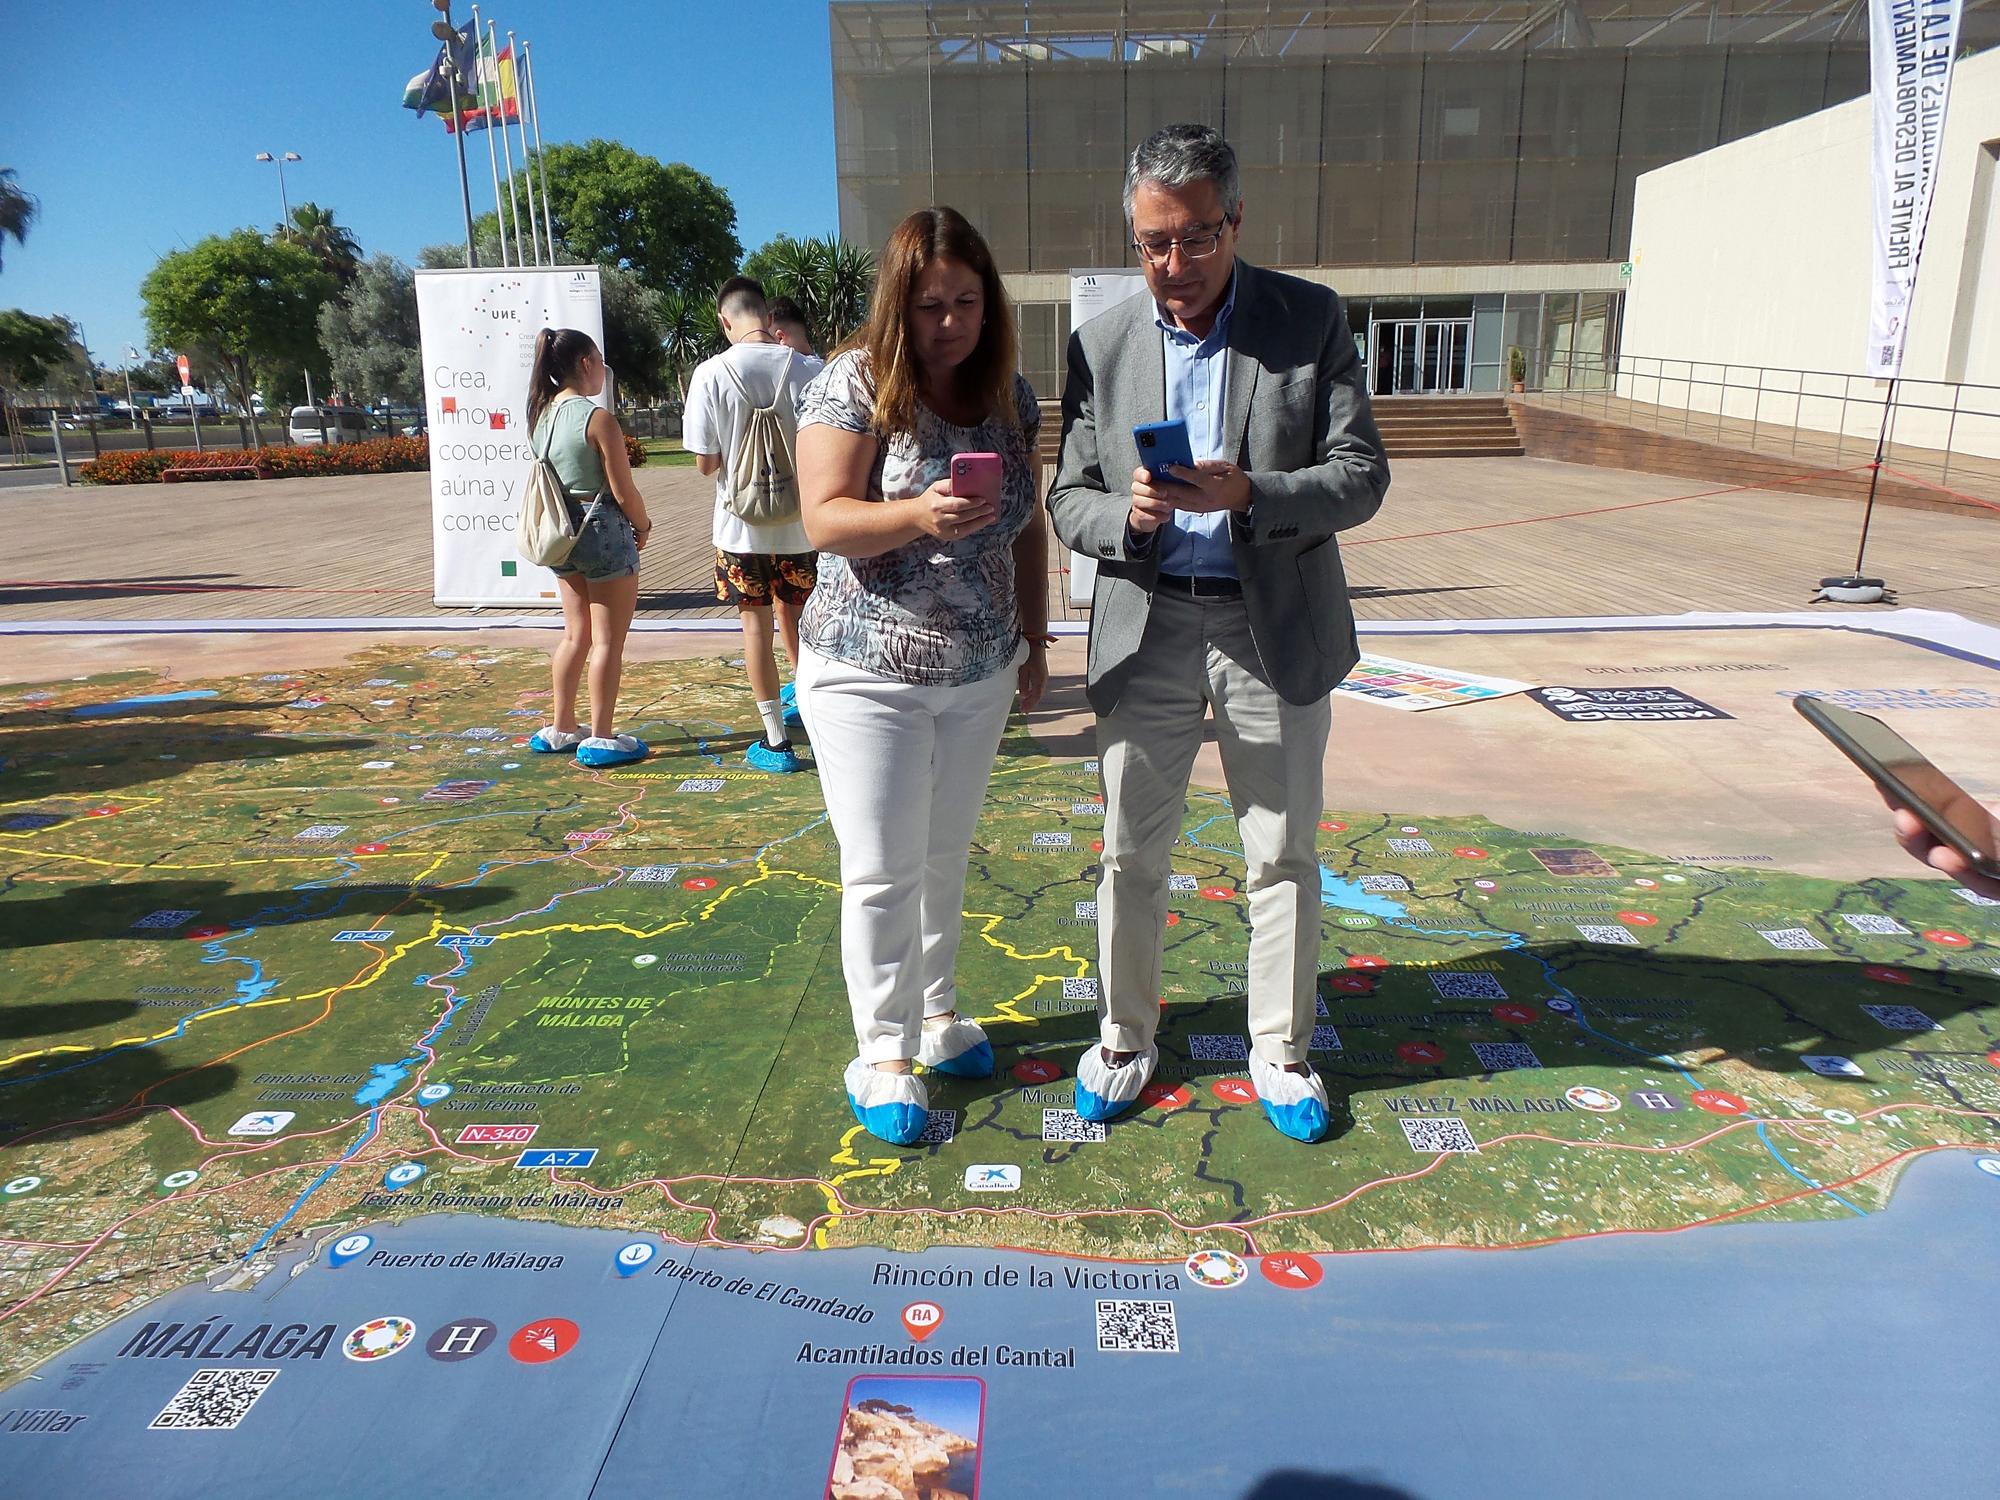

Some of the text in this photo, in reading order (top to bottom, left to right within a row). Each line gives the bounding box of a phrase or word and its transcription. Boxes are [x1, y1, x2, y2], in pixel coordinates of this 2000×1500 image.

[491, 310, 517, 320] UNE
[434, 365, 492, 392] Crea,
[436, 402, 517, 429] innova,
[440, 474, 515, 502] aúna y
[1585, 663, 1789, 676] COLABORADORES
[340, 931, 389, 941] AP-46
[448, 936, 487, 946] A-45
[1404, 959, 1504, 972] AXARQUÍA
[536, 996, 655, 1009] MONTES DE
[536, 1011, 624, 1027] MÁLAGA
[252, 1072, 365, 1085] Embalse del
[255, 1089, 346, 1102] Limonero
[456, 1083, 582, 1096] Acueducto de
[443, 1099, 537, 1112] San Telmo
[1382, 1094, 1576, 1113] VÉLEZ-MÁLAGA
[466, 1128, 530, 1141] N-340
[539, 1152, 580, 1166] A-7
[968, 1181, 1015, 1189] CaixaBank
[358, 1191, 624, 1210] Teatro Romano de Málaga
[365, 1250, 565, 1273] Puerto de Málaga
[872, 1262, 1181, 1291] Rincón de la Victoria
[653, 1258, 876, 1325] Puerto de El Candado
[911, 1308, 932, 1322] RA
[115, 1314, 338, 1361] MÁLAGA
[435, 1325, 489, 1353] H
[796, 1342, 1076, 1369] Acantilados del Cantal
[8, 1409, 88, 1433] Villar
